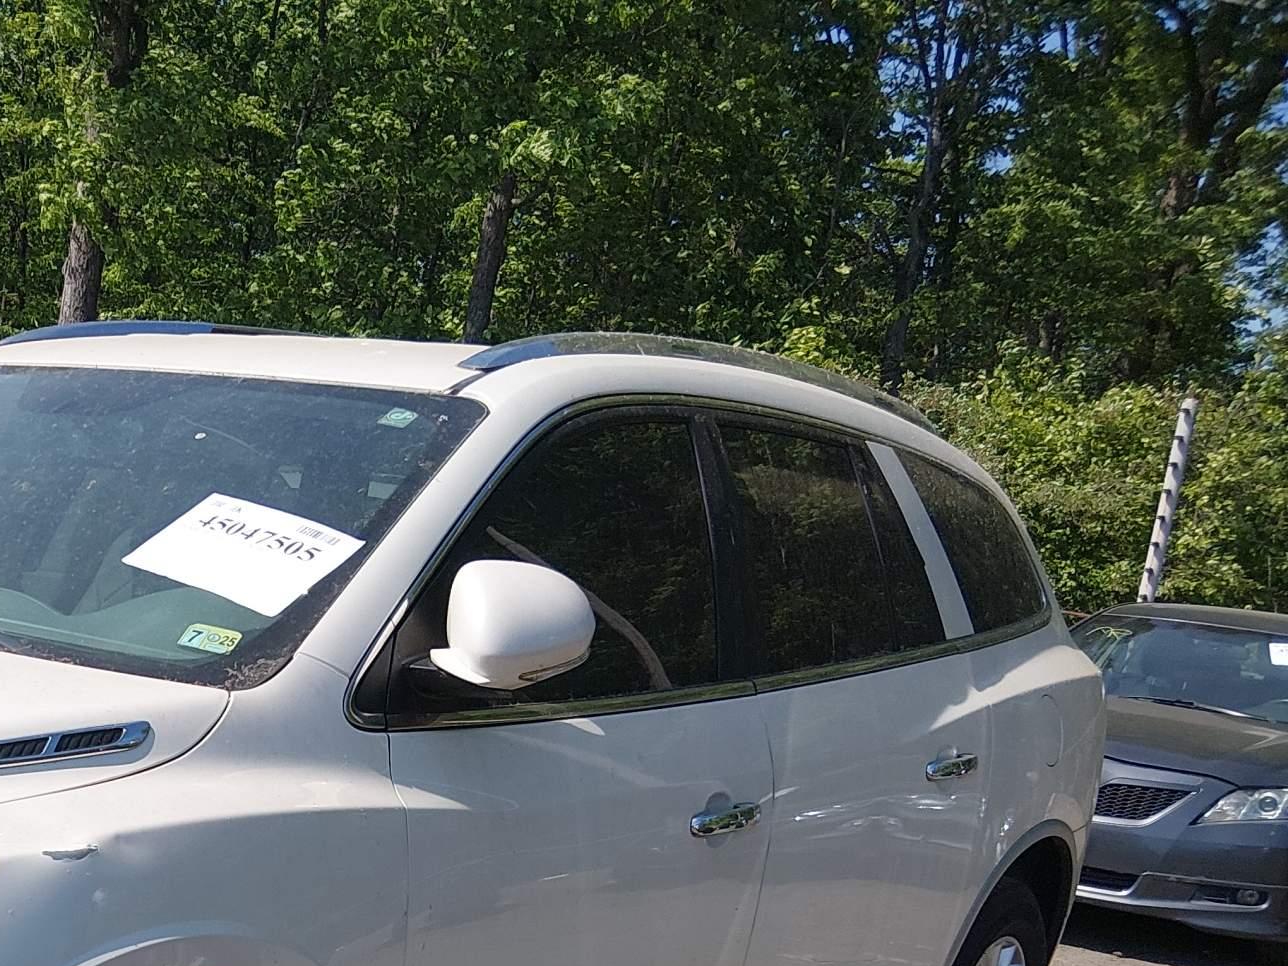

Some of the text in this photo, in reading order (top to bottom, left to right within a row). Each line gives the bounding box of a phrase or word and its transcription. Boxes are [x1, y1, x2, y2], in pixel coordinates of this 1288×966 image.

[198, 514, 323, 562] 45047505
[187, 629, 238, 648] 7 25
